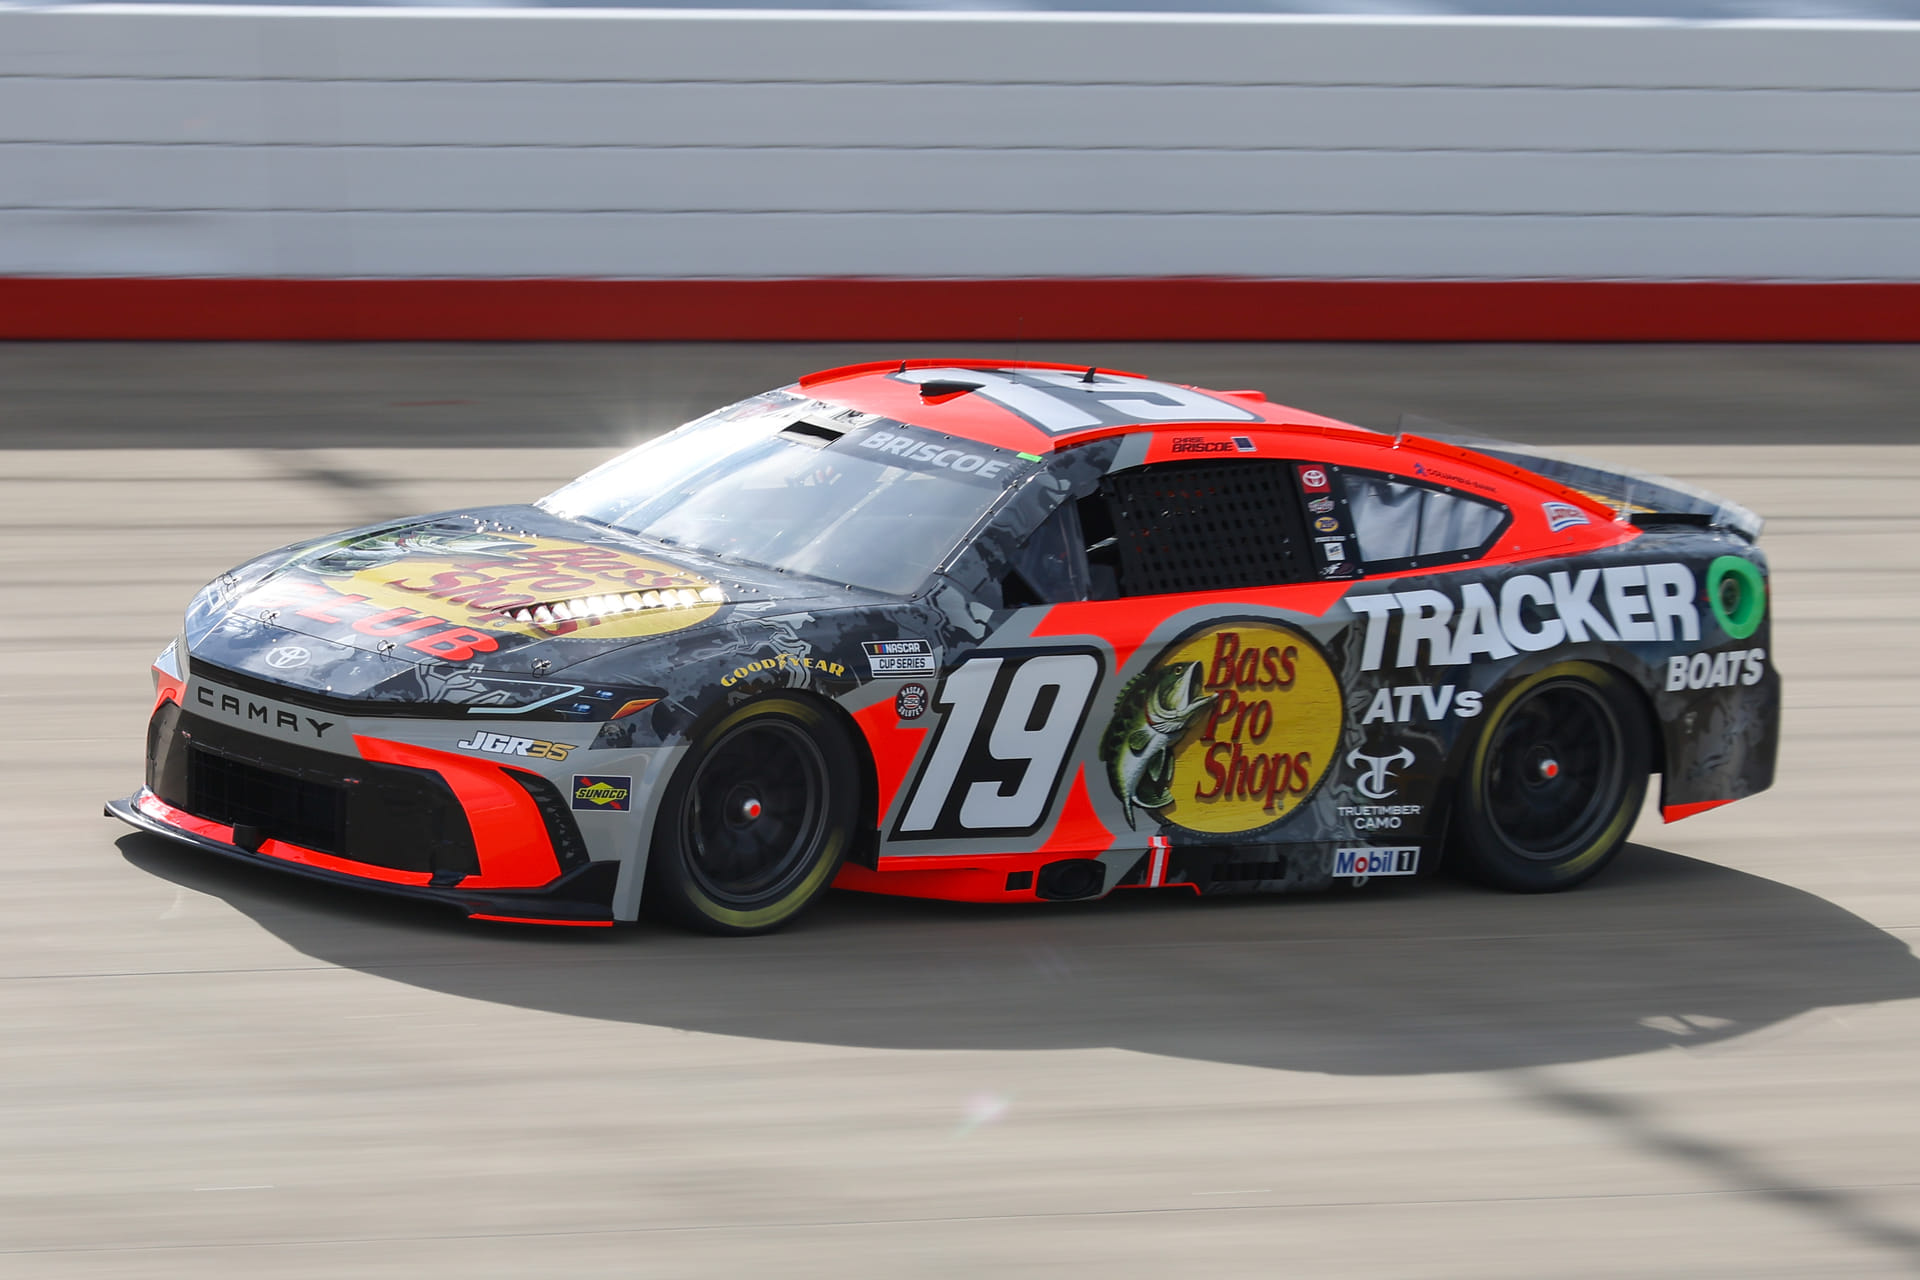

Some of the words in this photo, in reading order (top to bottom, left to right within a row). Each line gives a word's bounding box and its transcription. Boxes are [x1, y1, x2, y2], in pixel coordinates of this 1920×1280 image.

[860, 430, 1009, 480] BRISCOE
[1172, 442, 1233, 453] BRISCOE
[1344, 563, 1701, 672] TRACKER
[879, 658, 895, 669] CUP
[896, 657, 926, 669] SERIES
[886, 642, 921, 654] NASCAR
[1206, 632, 1299, 691] Bass
[720, 653, 846, 687] GOODYEAR
[1664, 648, 1766, 692] BOATS
[901, 686, 925, 697] NASCAR
[1361, 684, 1484, 726] ATVs
[197, 685, 335, 738] CAMRY
[898, 705, 924, 718] SALUTES
[1200, 690, 1272, 744] Pro
[898, 653, 1099, 832] 19
[1195, 741, 1312, 810] Shops
[577, 788, 627, 800] SUNOCO
[1337, 804, 1421, 817] TRUETIMBER
[1354, 816, 1402, 830] CAMO
[1335, 850, 1394, 874] Mobil
